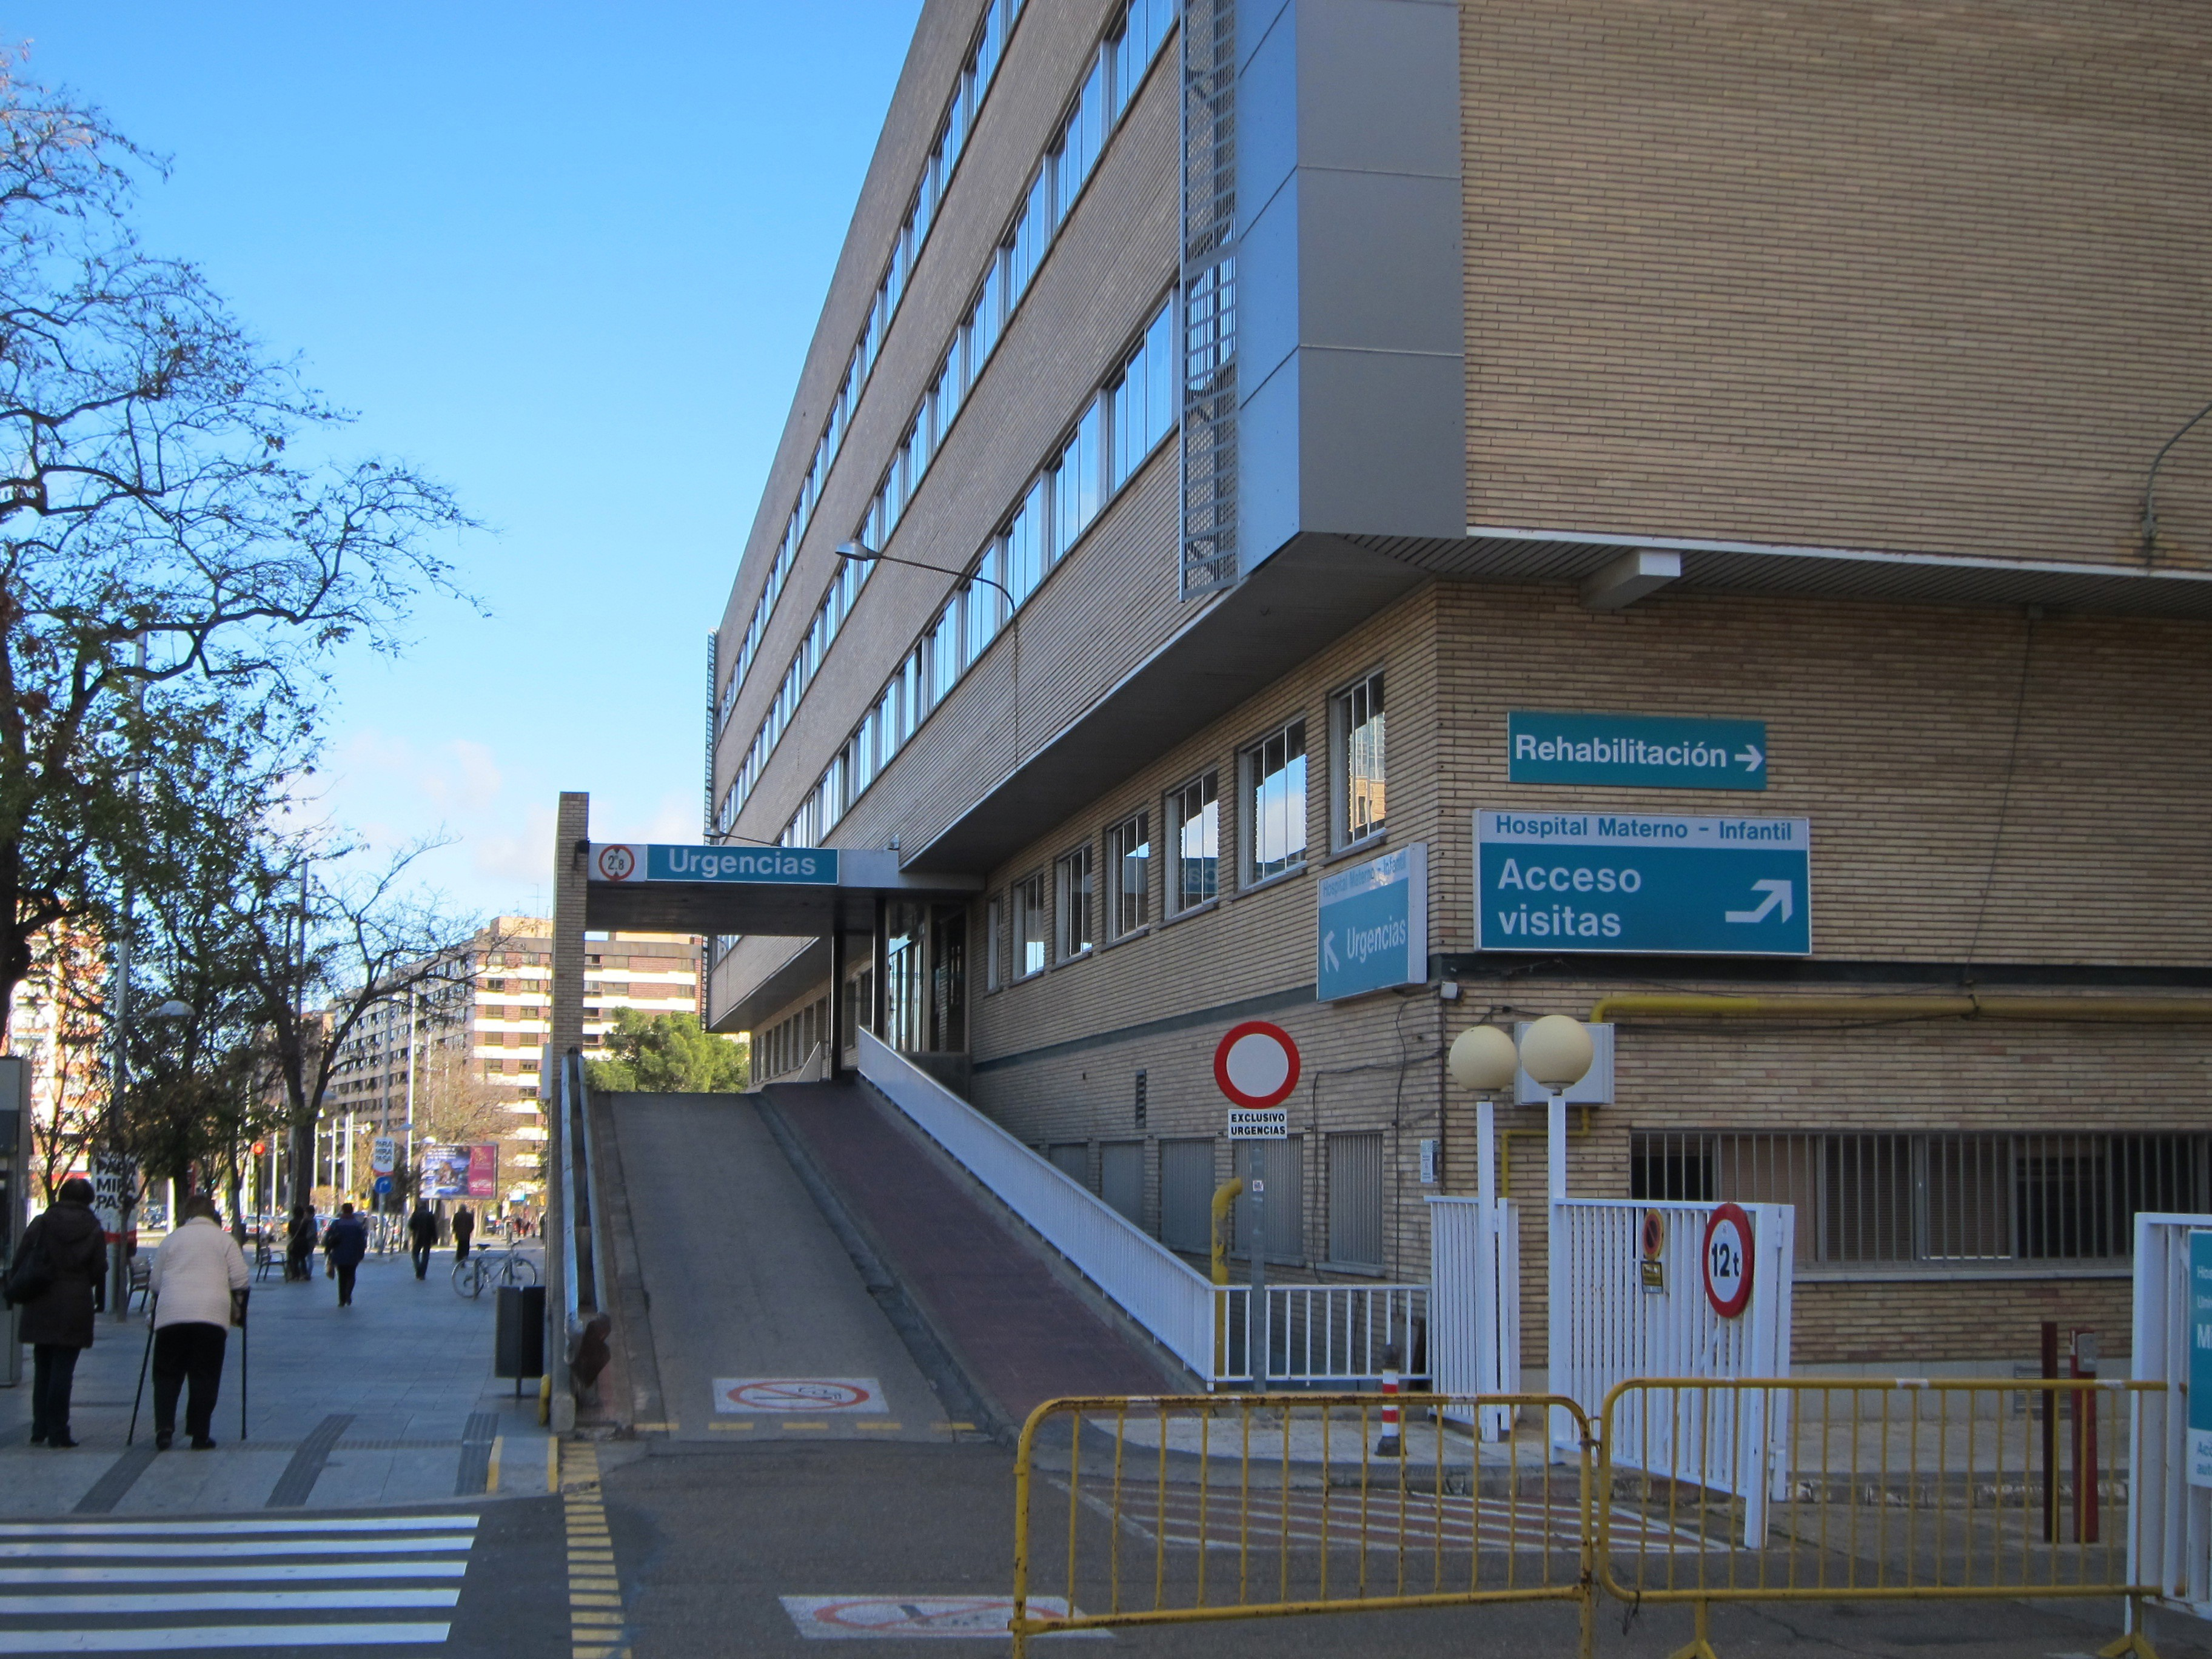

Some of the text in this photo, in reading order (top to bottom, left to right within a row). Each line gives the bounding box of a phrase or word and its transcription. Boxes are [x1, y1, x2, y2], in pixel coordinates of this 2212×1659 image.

[1516, 734, 1726, 767] Rehabilitación
[1496, 815, 1587, 839] Hospital
[1598, 817, 1688, 839] Materno
[1720, 820, 1792, 840] Infantil
[669, 848, 816, 878] Urgencias
[1497, 858, 1641, 893] Acceso
[1322, 874, 1348, 898] Hospital
[1498, 903, 1622, 937] visitas
[1347, 915, 1406, 964] Urgencias
[1231, 1113, 1285, 1122] EXCLUSIVO
[1231, 1125, 1285, 1135] URGENCIAS
[96, 1157, 136, 1176] PAA
